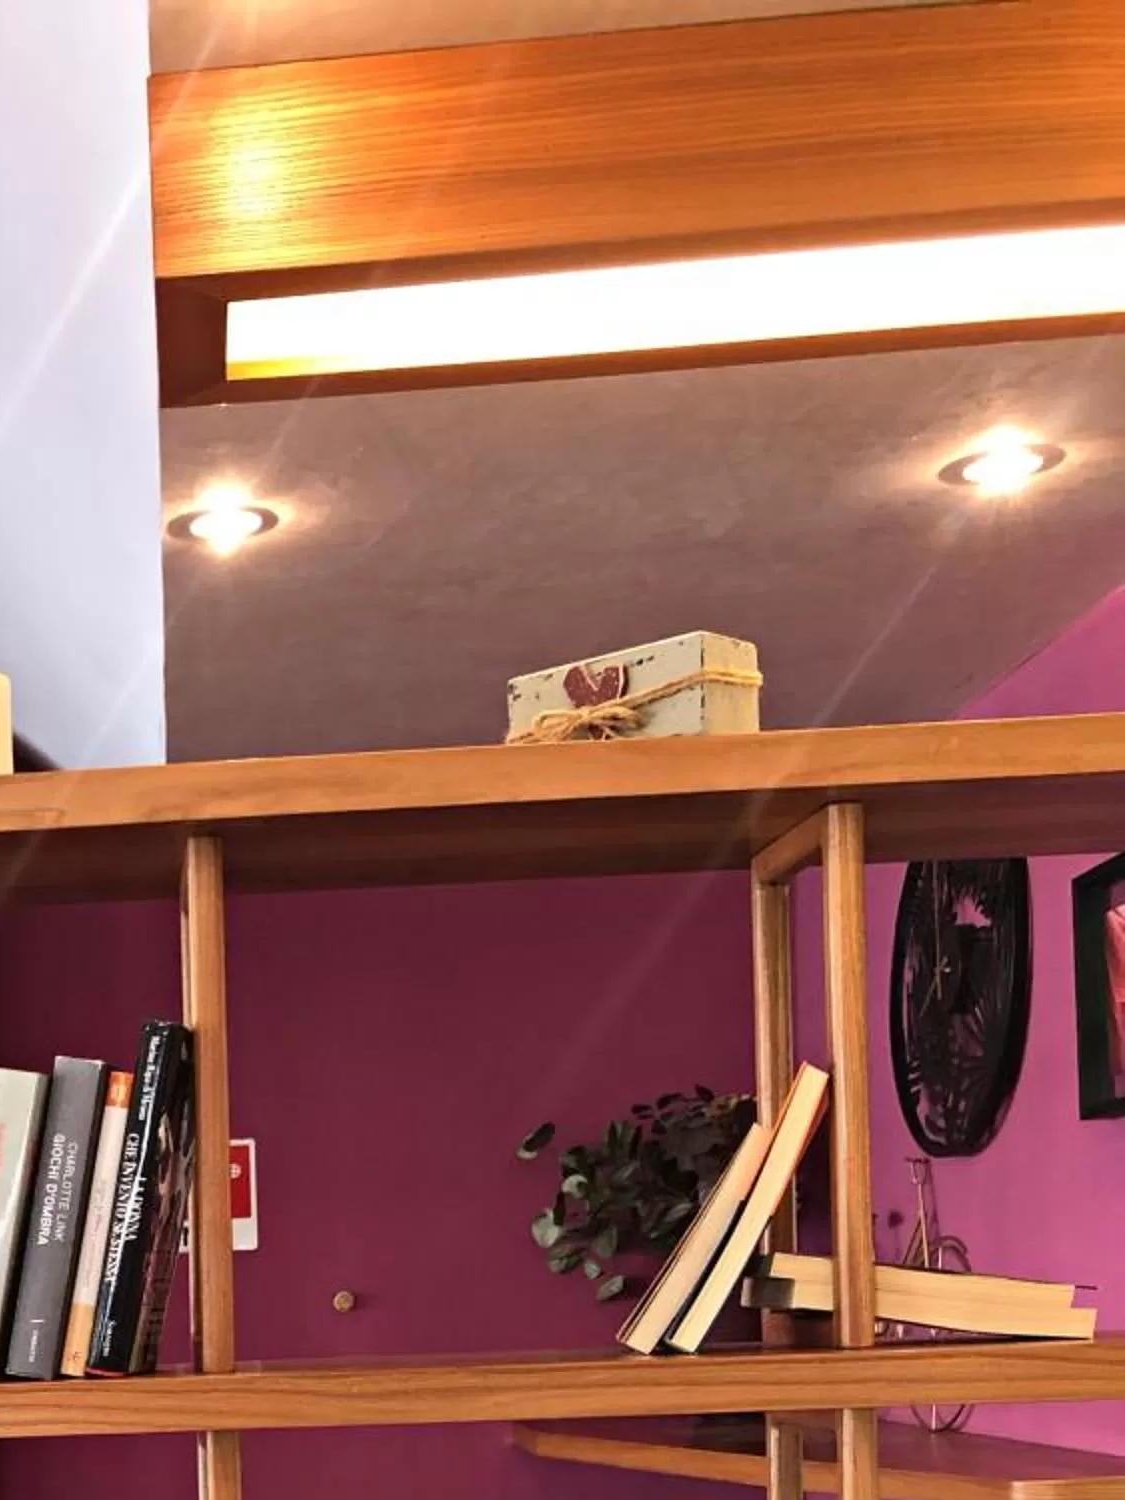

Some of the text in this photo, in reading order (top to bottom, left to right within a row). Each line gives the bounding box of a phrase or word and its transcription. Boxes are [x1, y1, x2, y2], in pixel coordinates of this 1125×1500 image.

[37, 1132, 66, 1246] GIOCHI D'OMBRA
[54, 1141, 78, 1243] CHARLOTTE LINK
